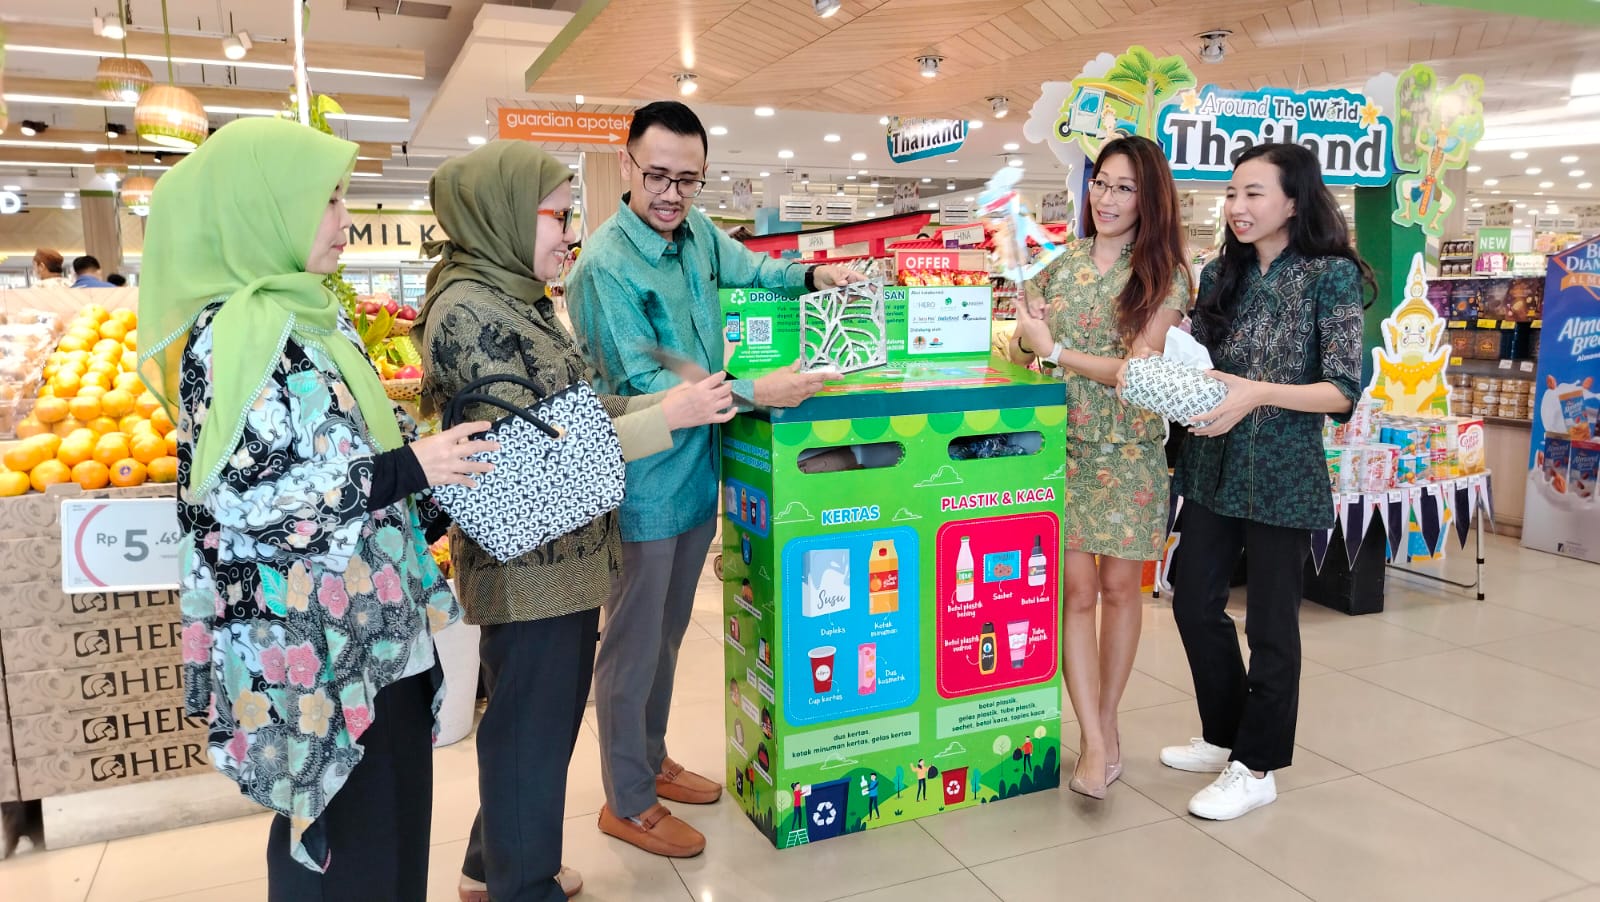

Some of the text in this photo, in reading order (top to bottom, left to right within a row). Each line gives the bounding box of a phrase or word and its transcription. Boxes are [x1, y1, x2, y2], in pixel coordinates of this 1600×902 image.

[1200, 96, 1268, 116] Around
[1274, 98, 1305, 118] The
[506, 112, 630, 132] guardian apotek
[815, 205, 823, 216] 2
[350, 223, 437, 246] MILK
[1481, 237, 1506, 250] NEW
[1586, 243, 1600, 259] B
[905, 257, 950, 269] OFFER
[1569, 275, 1600, 286] ALM
[941, 487, 1055, 511] PLASTIK & KACA
[822, 505, 880, 525] KERTAS
[97, 532, 118, 547] Rp
[123, 529, 149, 562] 5
[817, 589, 847, 610] Susu
[993, 592, 1014, 601] Sachet
[947, 600, 983, 613] Botol plastik
[874, 621, 893, 630] Kotak
[885, 669, 897, 677] Dus
[808, 694, 843, 706] Cup kertas
[978, 701, 995, 710] botol
[122, 706, 210, 738] HER
[958, 713, 976, 723] gelas
[1000, 706, 1014, 715] tube
[975, 718, 992, 728] botol
[1010, 712, 1030, 722] toples
[1030, 709, 1046, 718] kaca
[792, 749, 812, 758] kotak
[813, 743, 845, 753] minuman
[872, 734, 890, 744] gelas
[890, 730, 912, 740] kertas
[833, 733, 846, 741] dus
[130, 743, 208, 776] HER
